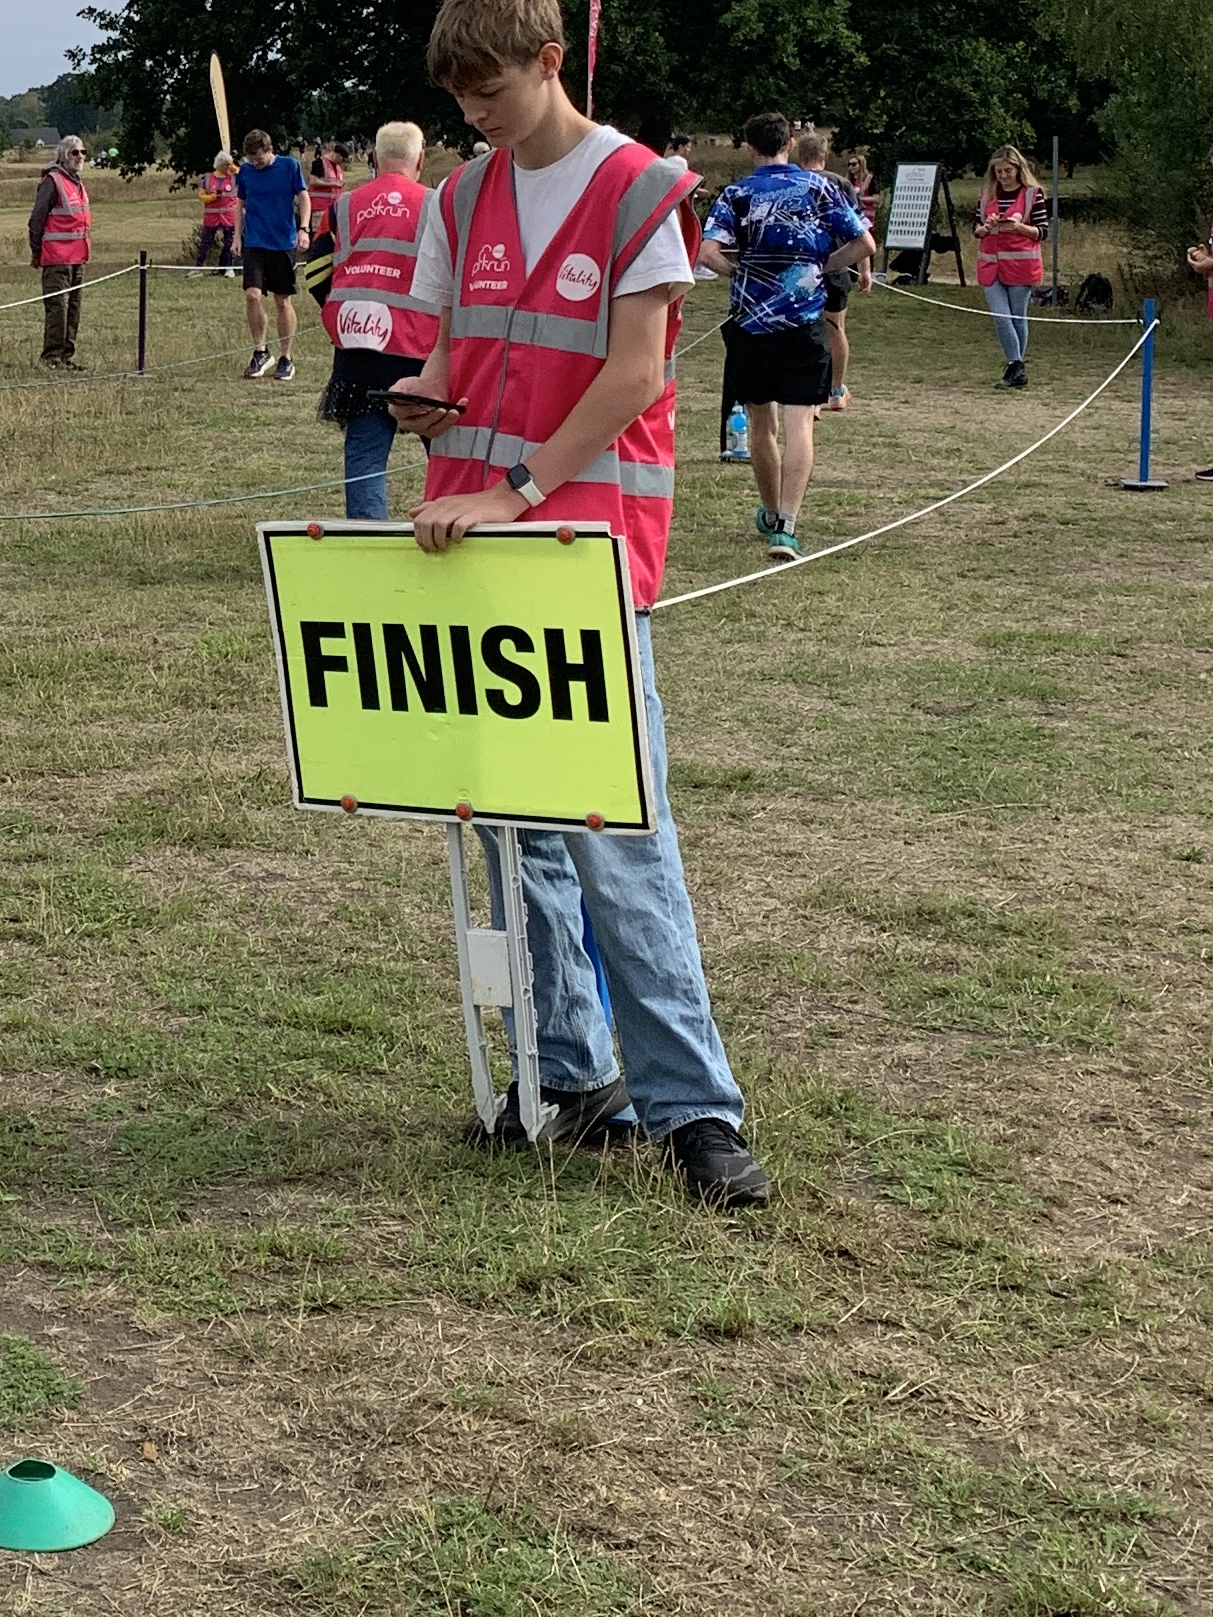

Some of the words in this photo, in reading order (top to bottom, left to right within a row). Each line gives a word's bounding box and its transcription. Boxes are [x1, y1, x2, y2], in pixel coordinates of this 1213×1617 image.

[357, 196, 409, 224] parkrun
[344, 264, 401, 278] VOLUNTEER
[339, 307, 389, 345] Vitality
[299, 620, 610, 723] FINISH
